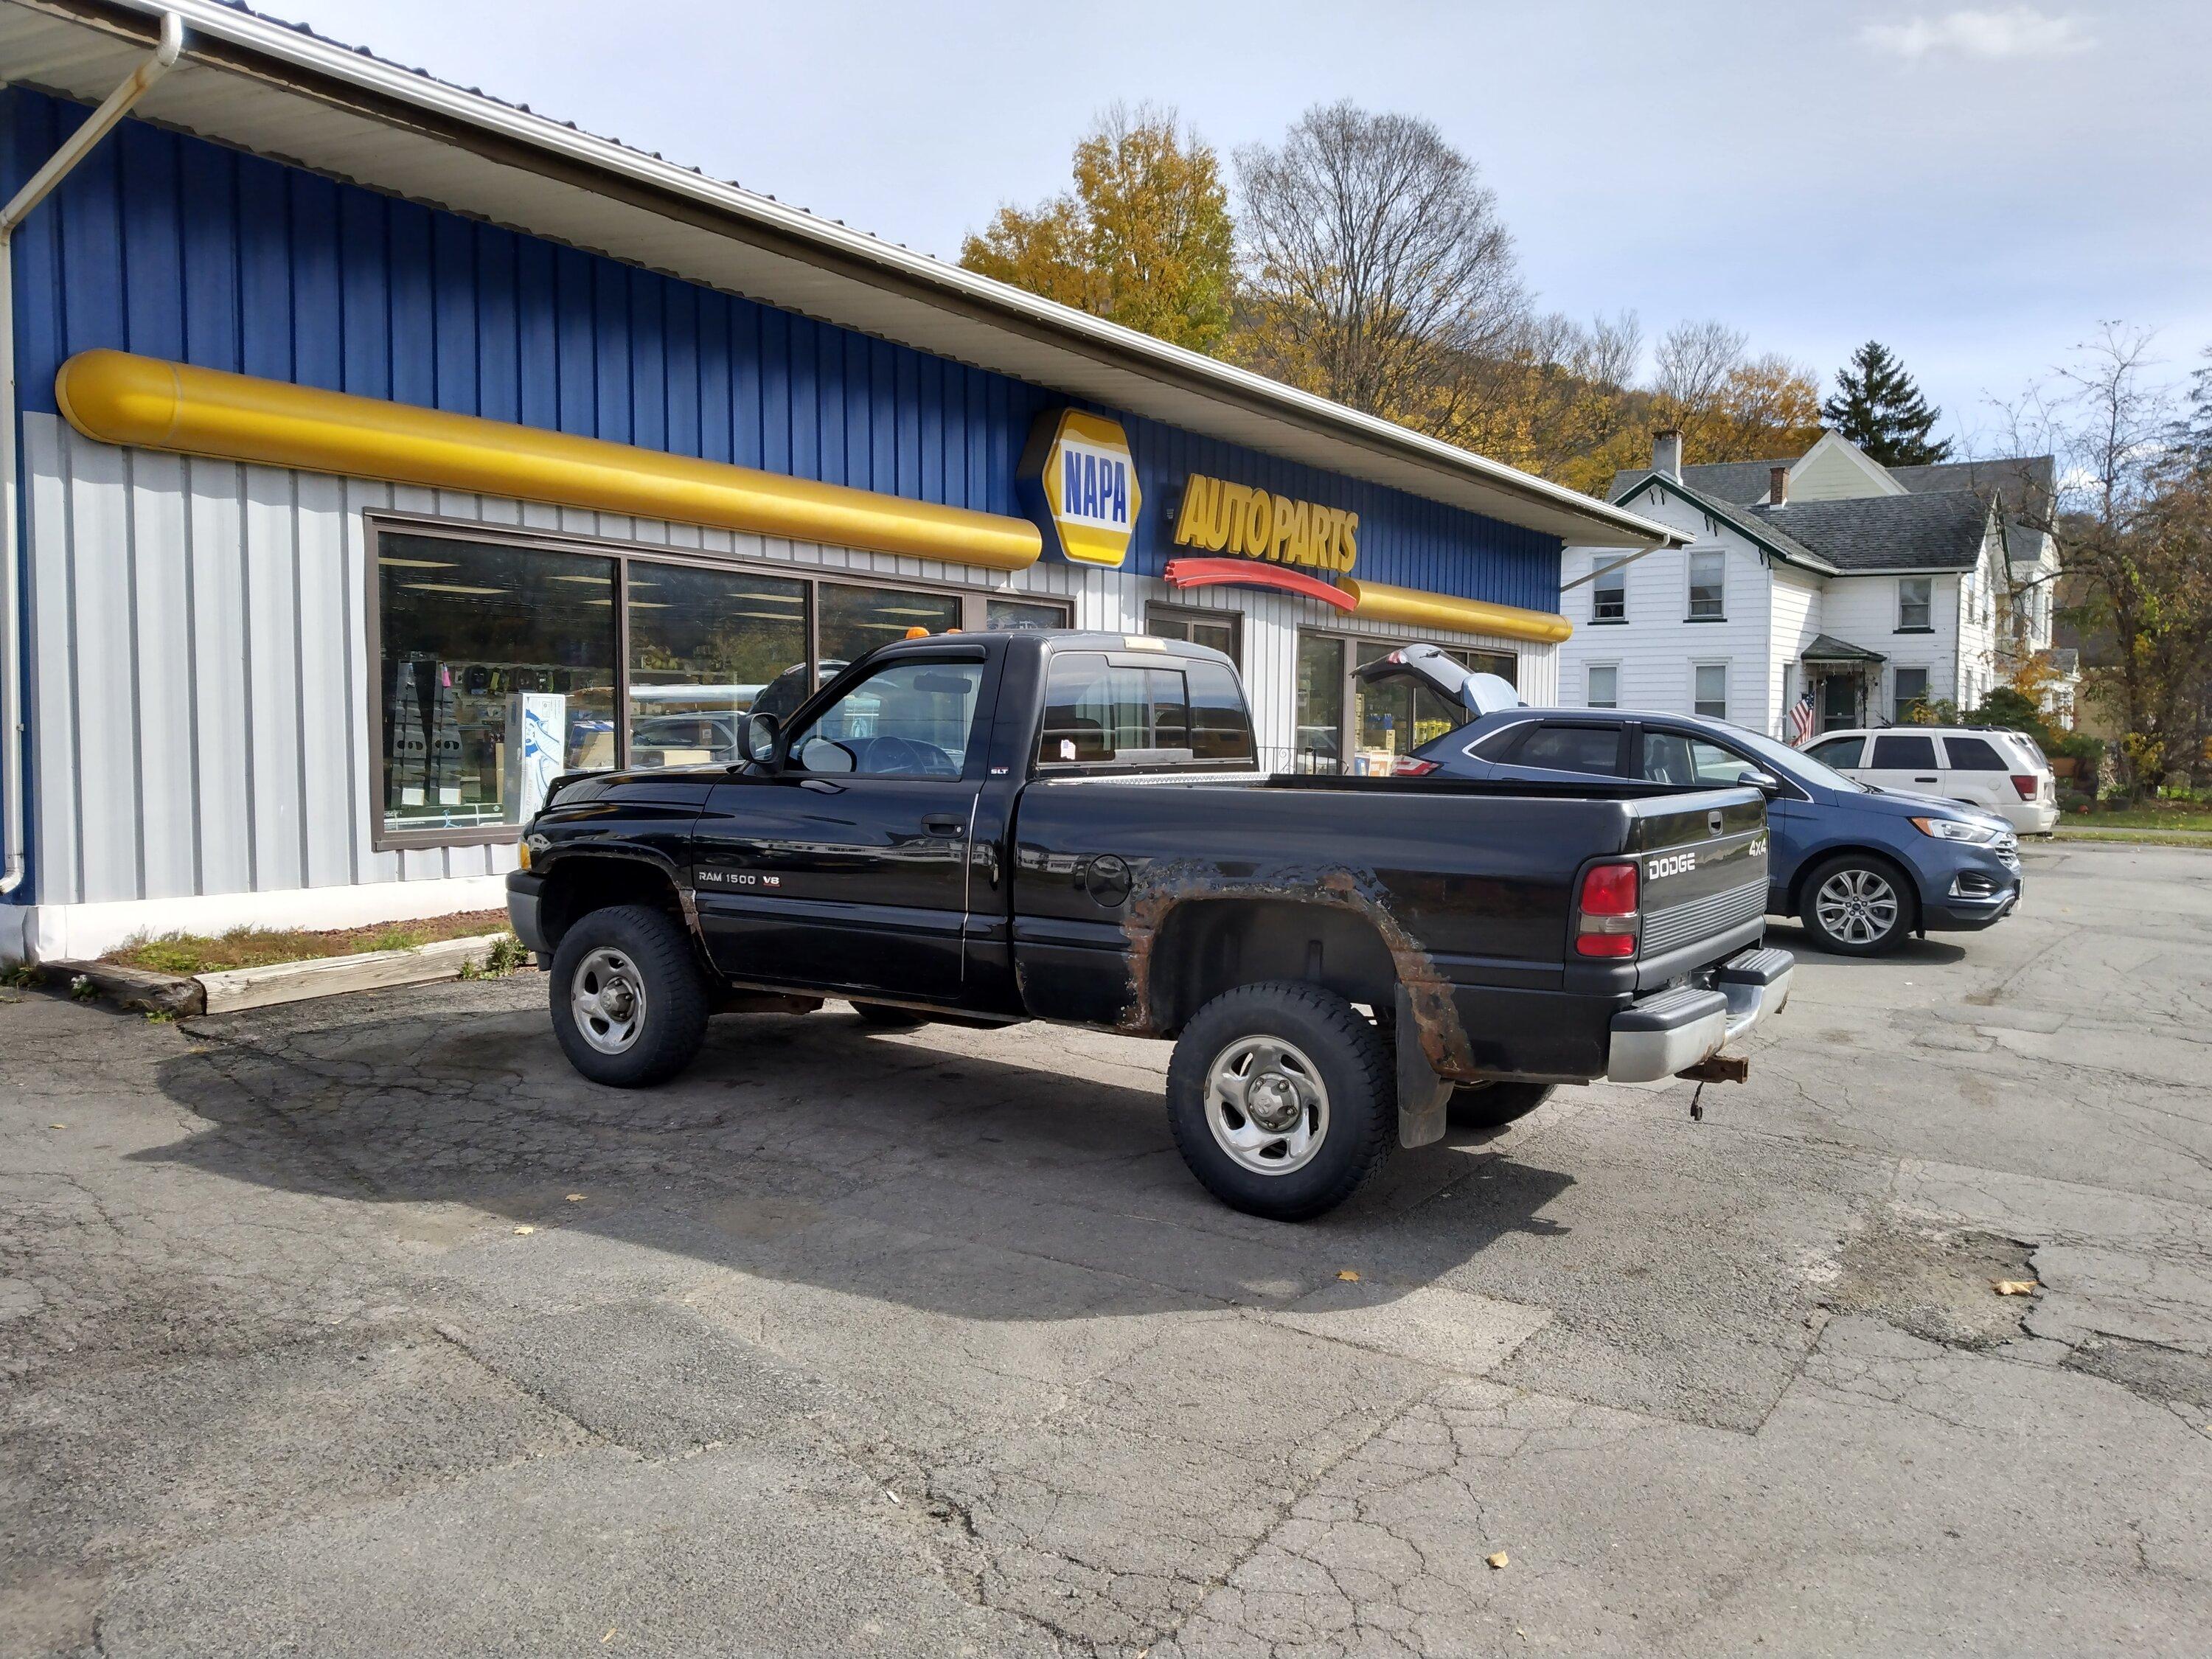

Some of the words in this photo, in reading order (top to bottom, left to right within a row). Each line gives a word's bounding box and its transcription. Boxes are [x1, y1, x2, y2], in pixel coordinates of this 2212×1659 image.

[1065, 451, 1127, 524] NAPA
[699, 872, 722, 882] RAM
[726, 874, 756, 885] 1500
[762, 876, 780, 884] V8
[1649, 852, 1695, 880] DODGE
